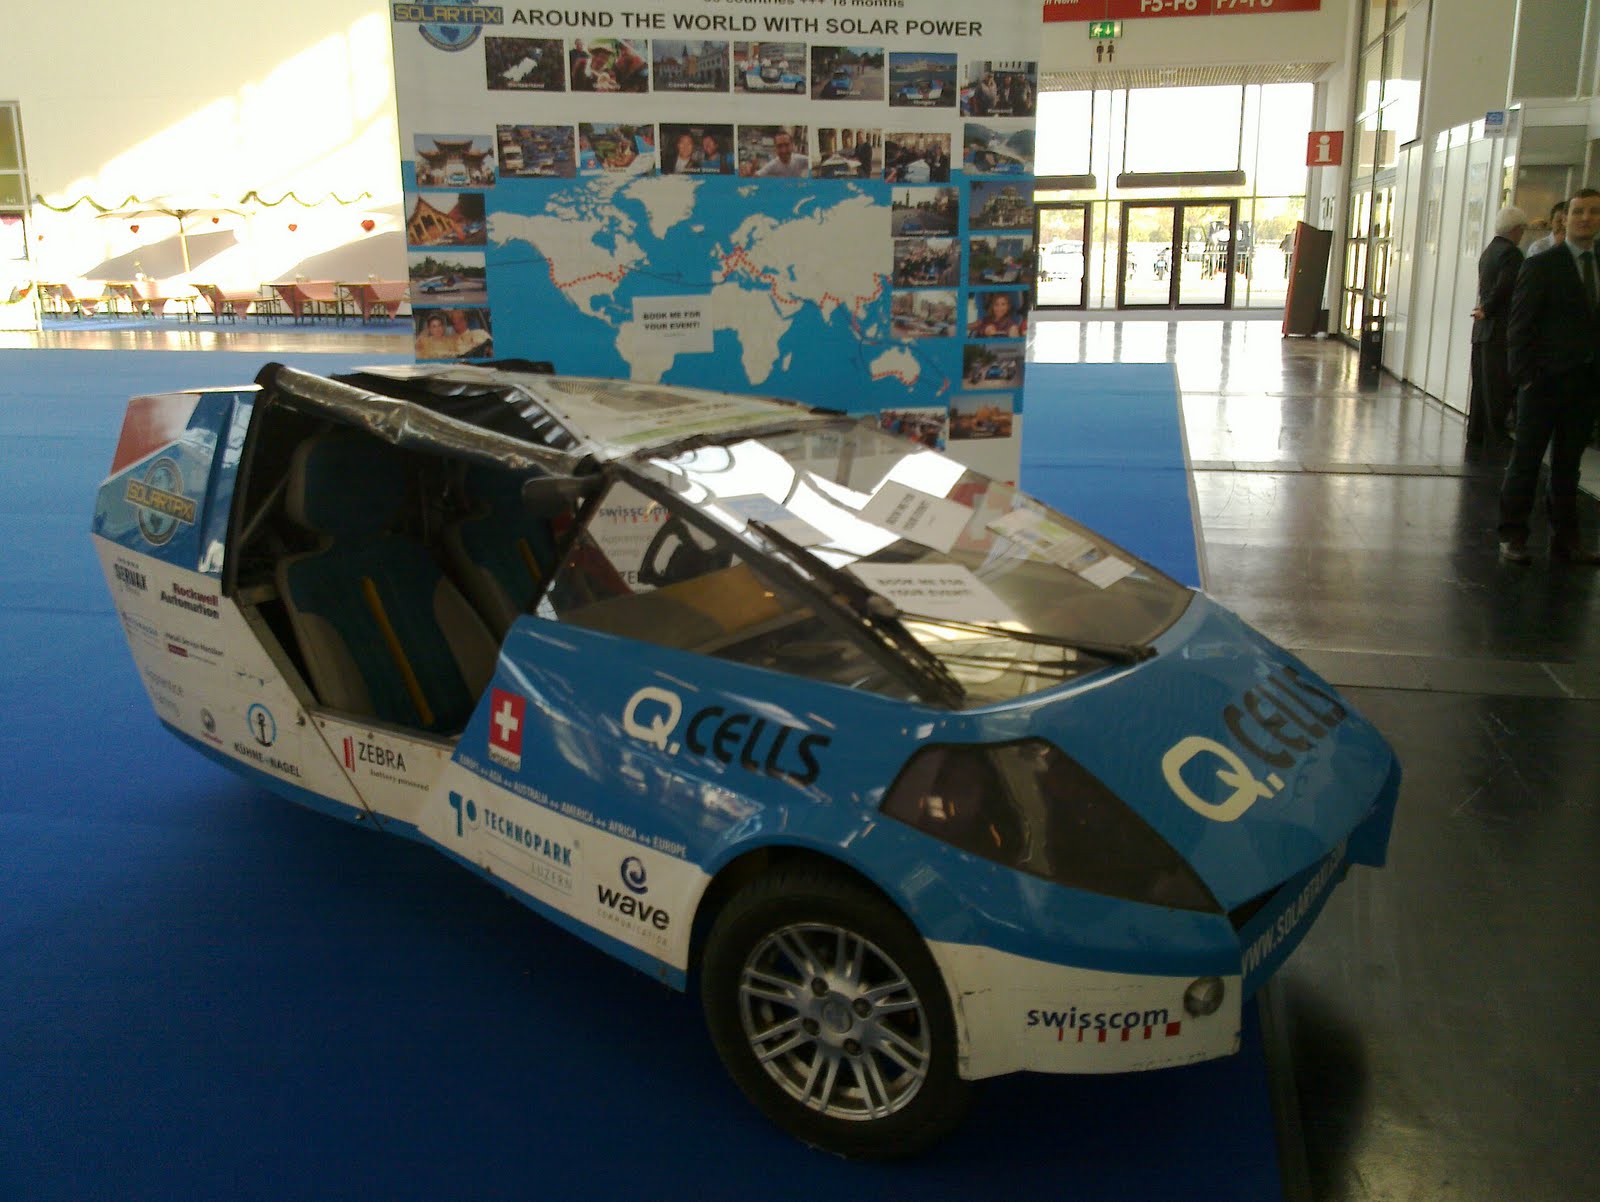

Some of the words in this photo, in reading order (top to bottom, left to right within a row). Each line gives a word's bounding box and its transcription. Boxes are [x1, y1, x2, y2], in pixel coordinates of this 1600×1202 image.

[395, 4, 502, 25] SOLARTAXI
[512, 9, 614, 29] AROUND
[621, 12, 666, 29] THE
[673, 14, 757, 32] WORLD
[764, 17, 819, 33] WITH
[826, 18, 899, 35] SOLAR
[905, 20, 983, 37] POWER
[643, 311, 667, 320] BOOK
[669, 311, 681, 319] ME
[684, 311, 701, 319] FOR
[644, 321, 668, 331] YOUR
[160, 590, 220, 619] Automation
[172, 582, 219, 607] Rockwell
[358, 741, 407, 772] ZEBRA
[608, 819, 638, 840] AFRICA
[653, 835, 687, 859] EUROPE
[597, 884, 671, 931] wave
[1026, 1005, 1169, 1030] swisscom
